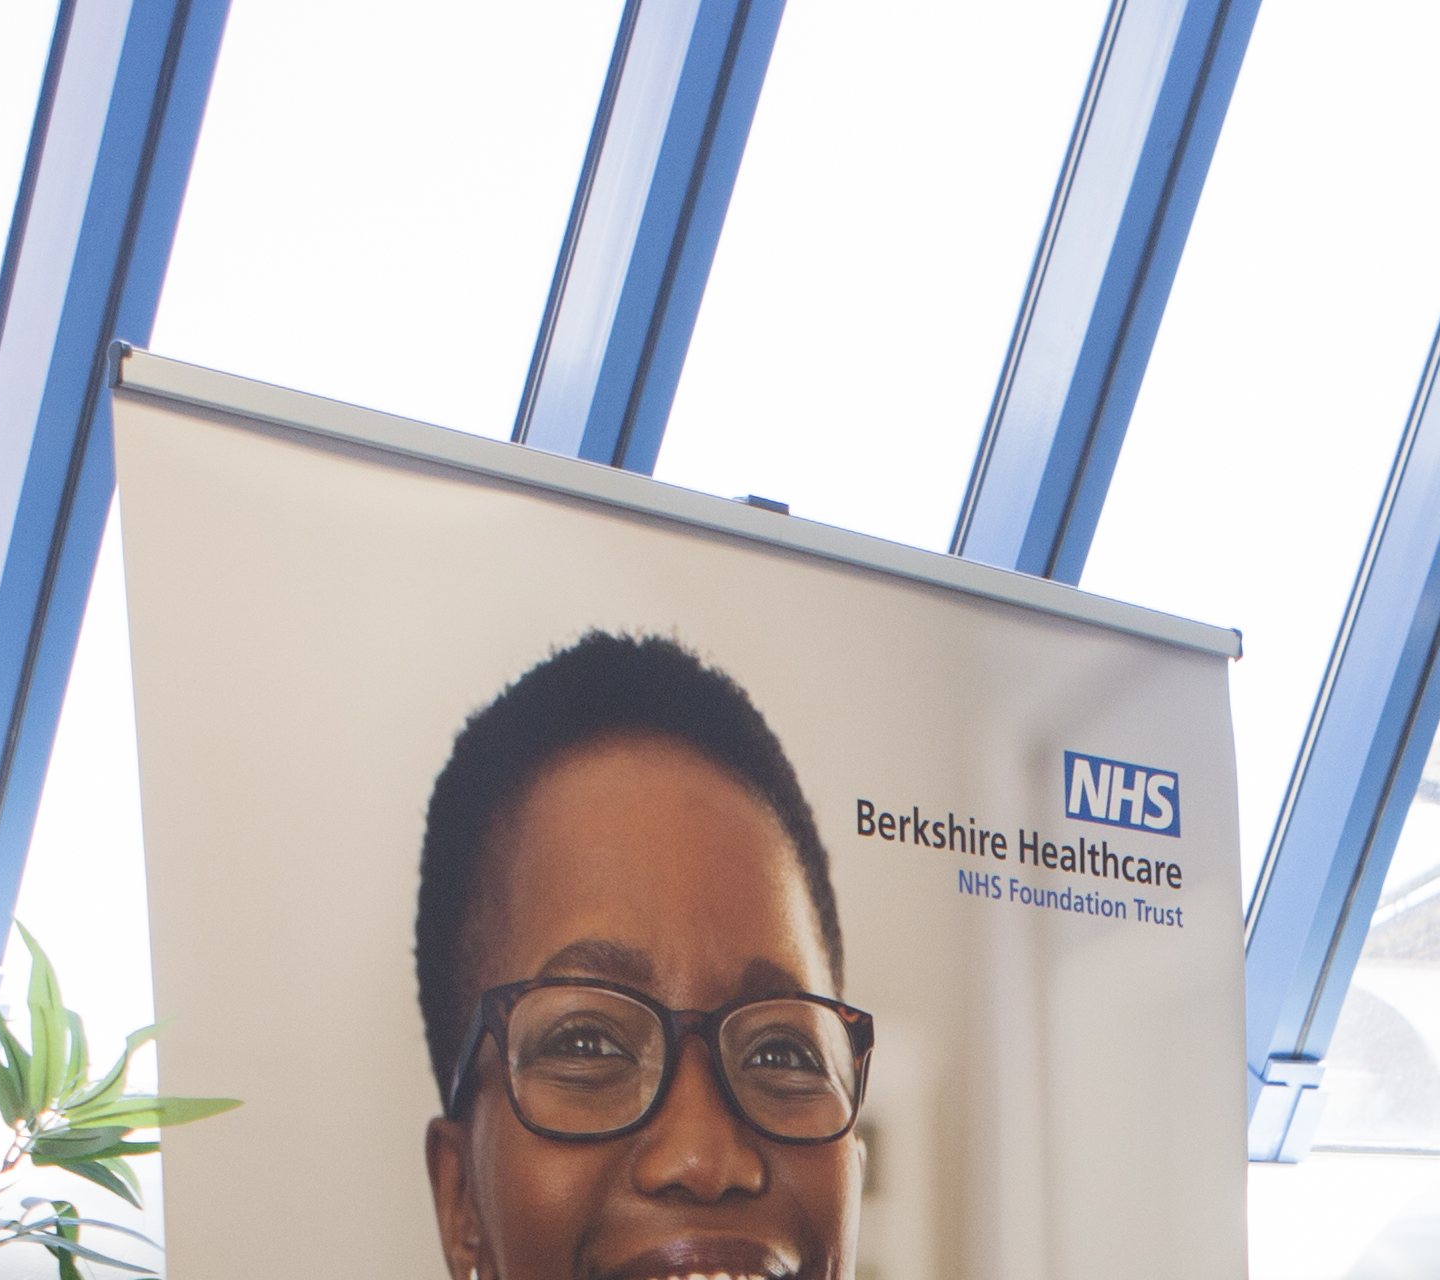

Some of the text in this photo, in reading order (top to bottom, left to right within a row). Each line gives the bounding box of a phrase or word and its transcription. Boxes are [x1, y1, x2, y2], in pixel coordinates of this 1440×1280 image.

[1068, 758, 1175, 830] NHS
[856, 798, 1183, 889] Berkshire Healthcare
[959, 869, 1183, 928] NHS Foundation Trust
